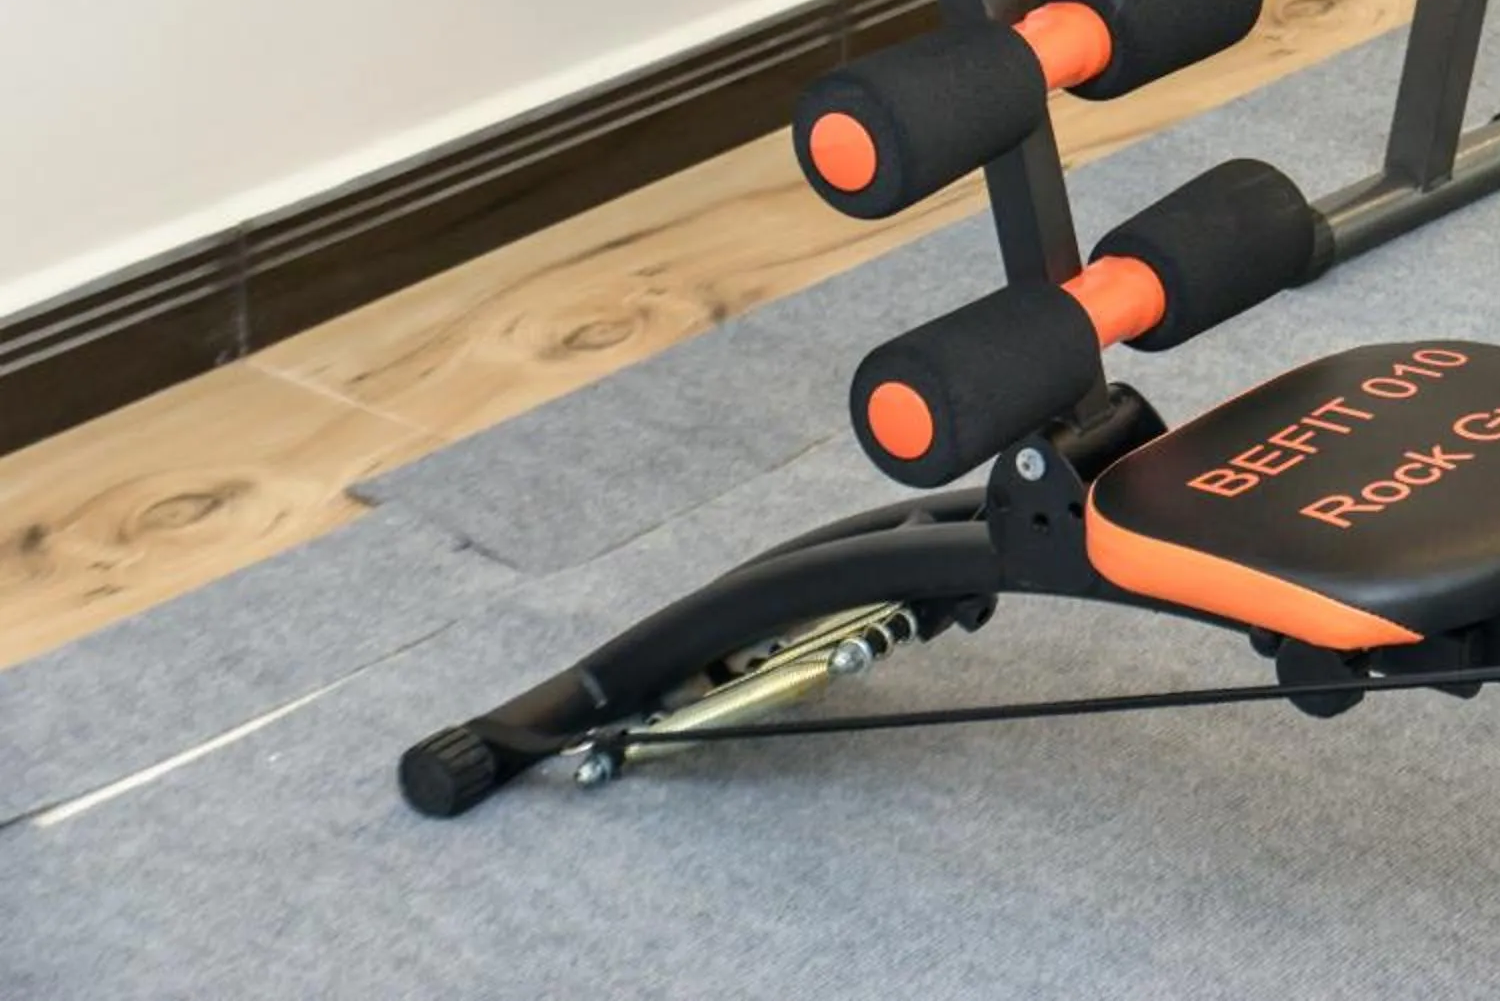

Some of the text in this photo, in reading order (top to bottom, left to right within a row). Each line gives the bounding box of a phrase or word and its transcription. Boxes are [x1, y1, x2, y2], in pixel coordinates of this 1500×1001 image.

[1187, 348, 1469, 497] BEFIT 010
[1300, 444, 1475, 529] Rock
